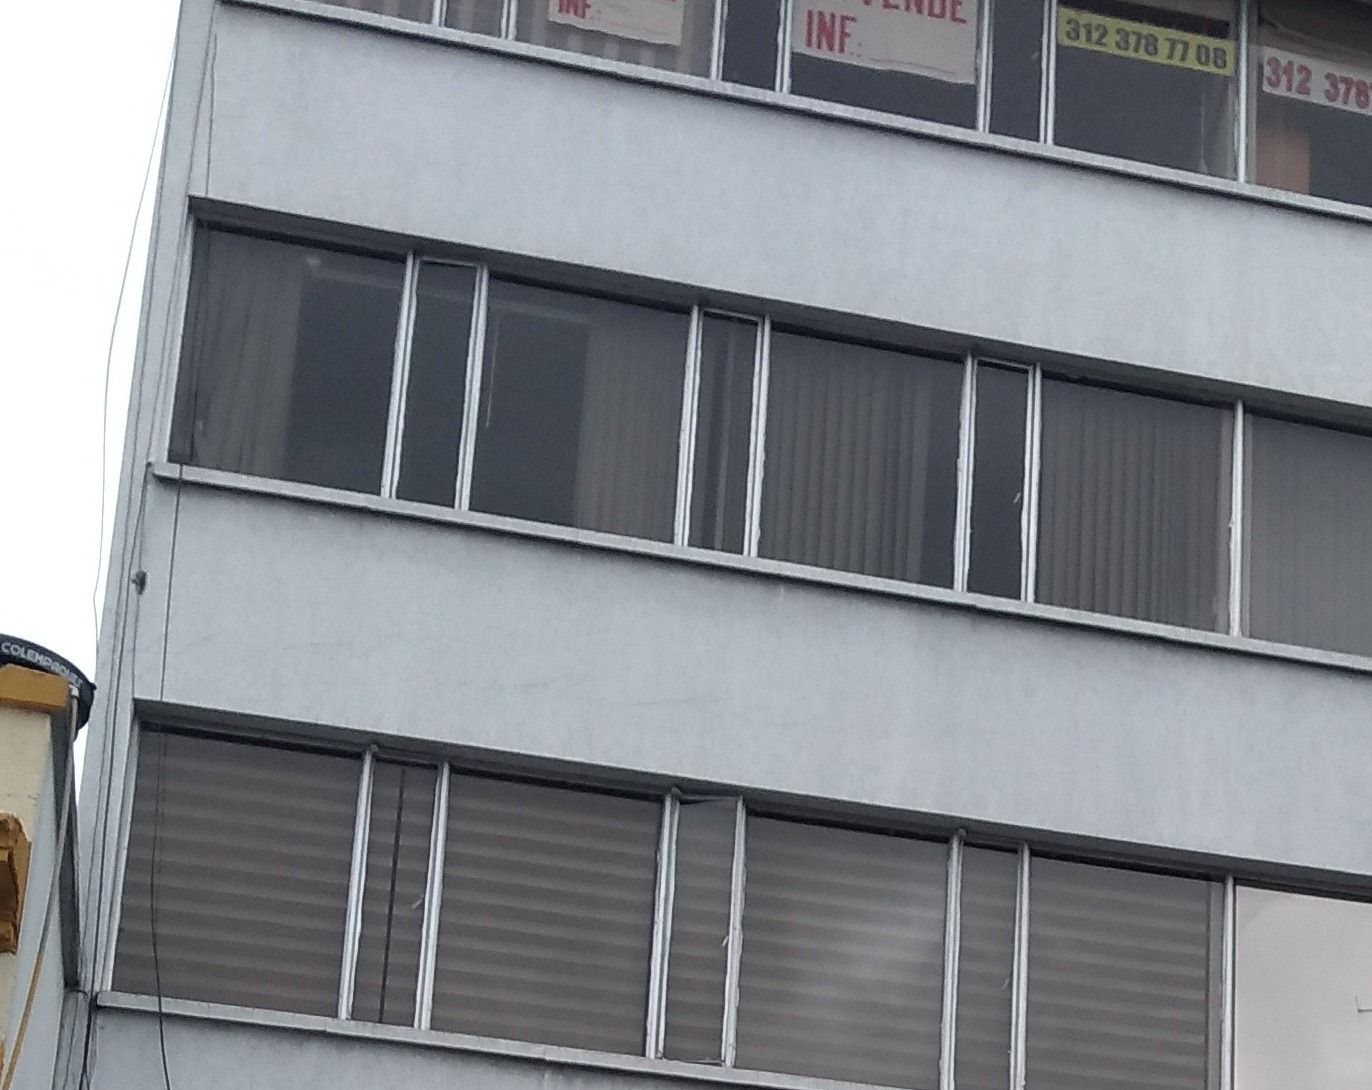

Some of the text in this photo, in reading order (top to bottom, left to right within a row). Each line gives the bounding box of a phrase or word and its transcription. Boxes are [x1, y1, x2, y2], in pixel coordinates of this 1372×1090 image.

[1065, 17, 1108, 46] 312
[1115, 28, 1158, 56] 378
[1266, 56, 1312, 96] 312
